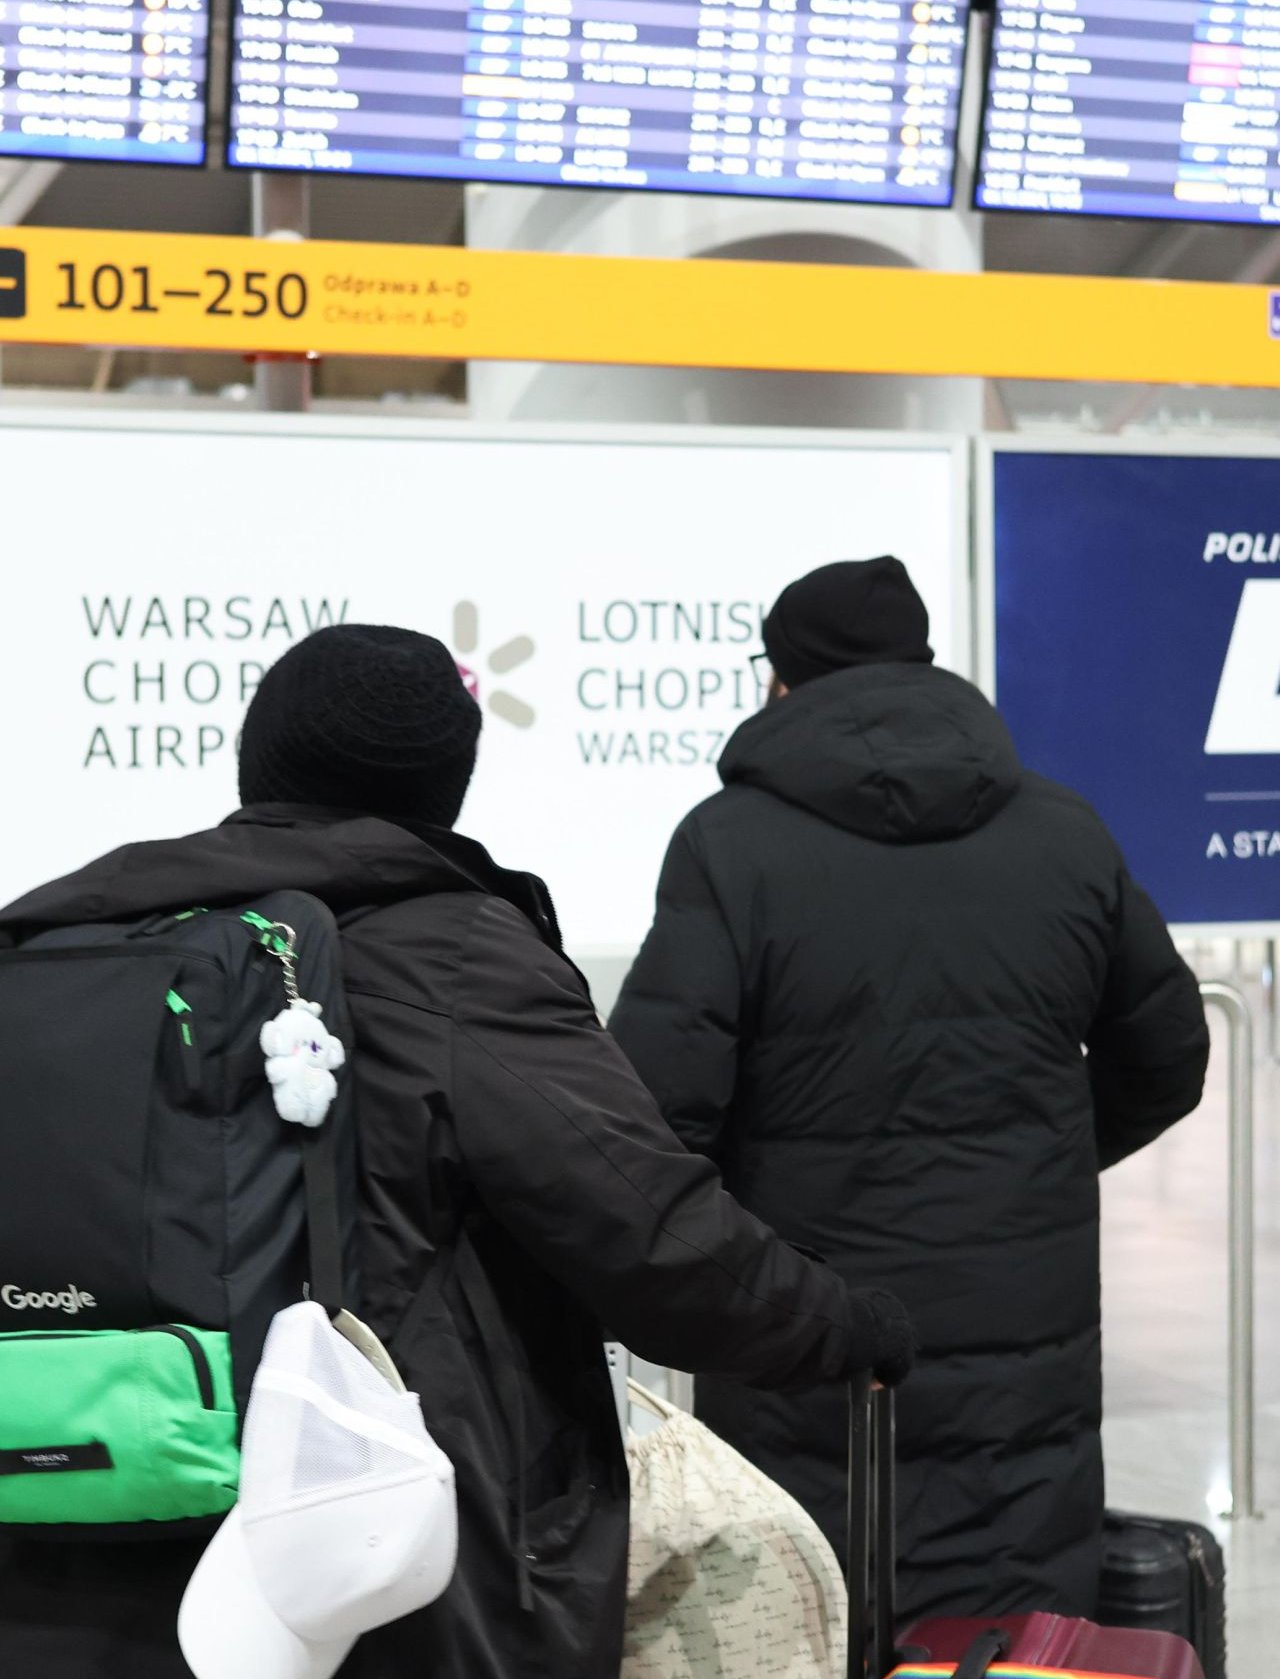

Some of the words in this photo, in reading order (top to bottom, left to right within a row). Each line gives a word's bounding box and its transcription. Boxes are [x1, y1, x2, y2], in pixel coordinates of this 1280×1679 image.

[324, 273, 420, 297] Odprawa
[322, 303, 417, 327] Check-in
[81, 595, 350, 639] WARSAW
[578, 600, 768, 643] LOTNIS
[82, 659, 268, 705] CHOP
[83, 724, 240, 769] AIRP
[1206, 832, 1227, 858] A
[0, 1283, 97, 1314] Google
